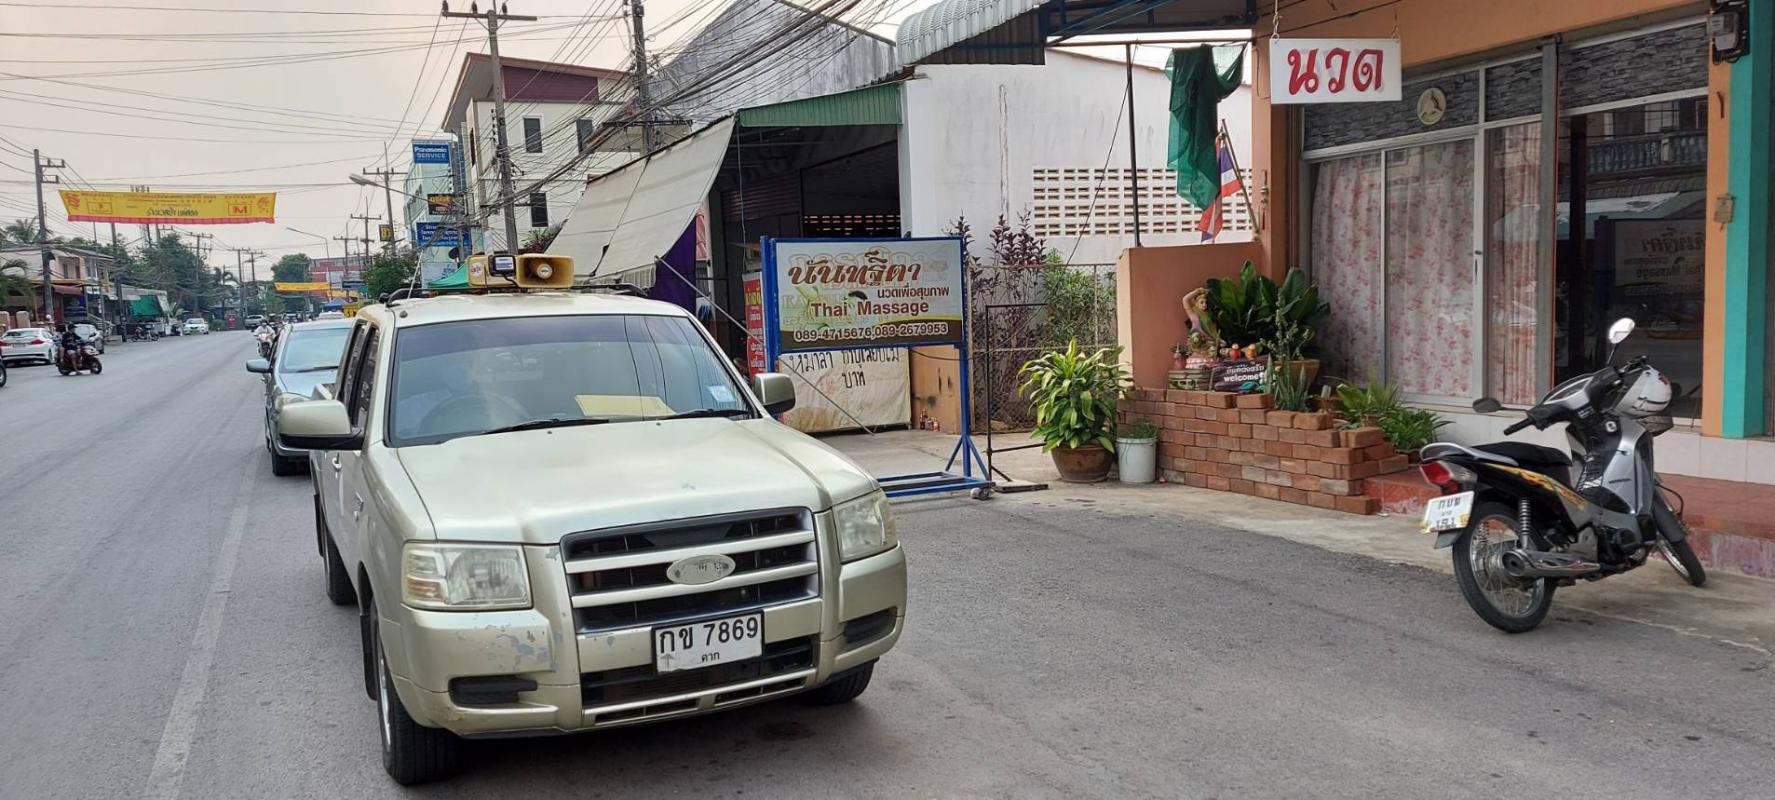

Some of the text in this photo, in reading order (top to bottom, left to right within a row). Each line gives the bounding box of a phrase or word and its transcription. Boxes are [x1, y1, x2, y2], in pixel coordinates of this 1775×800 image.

[1287, 47, 1384, 96] นวด
[877, 282, 949, 300] นวดเพื่อสุขภาพ
[811, 299, 848, 317] Thai
[858, 300, 929, 318] Massage
[842, 370, 866, 389] บาท
[659, 617, 759, 654] กข 7869
